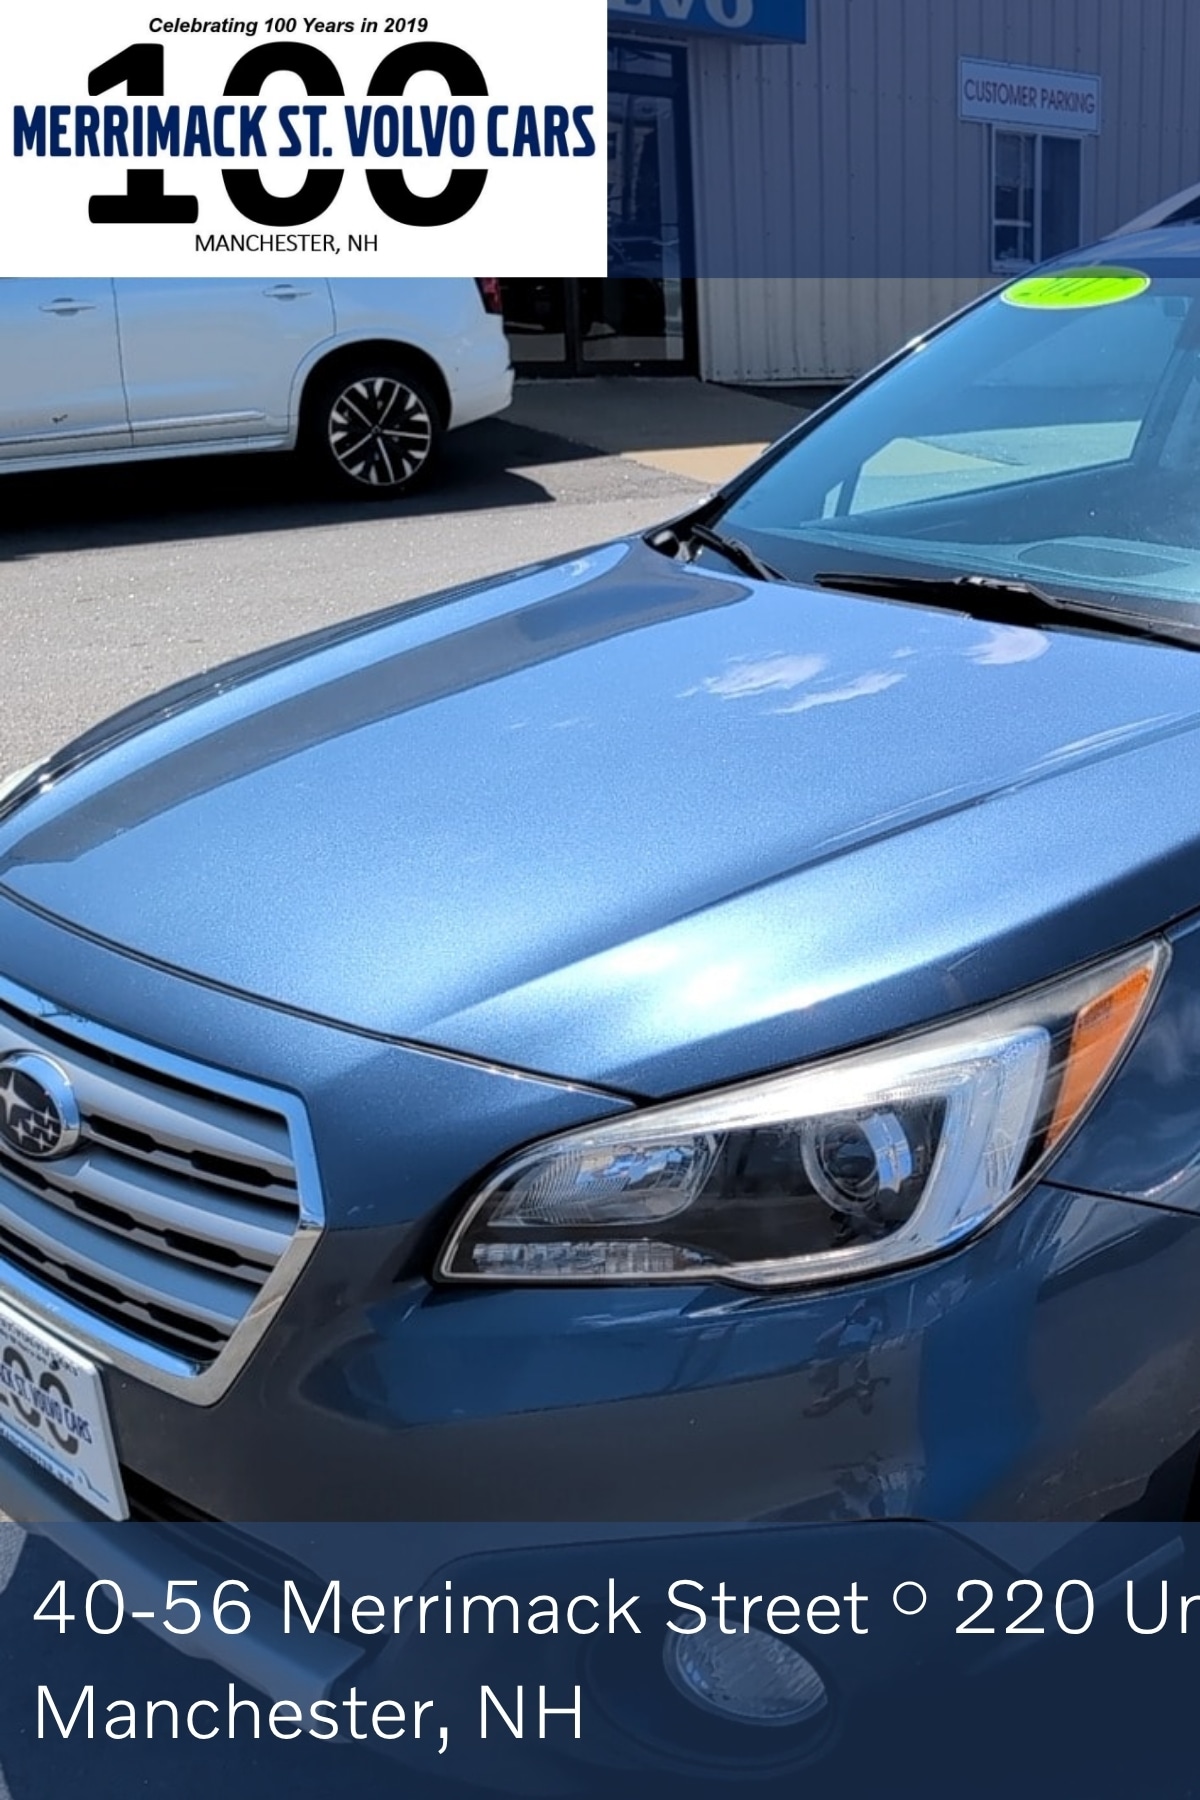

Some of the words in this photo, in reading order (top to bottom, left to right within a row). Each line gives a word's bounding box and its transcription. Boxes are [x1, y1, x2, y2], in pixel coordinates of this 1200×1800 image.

[963, 79, 1037, 109] CUSTOMER
[1041, 88, 1096, 114] PARKING
[63, 1407, 93, 1445] CARS
